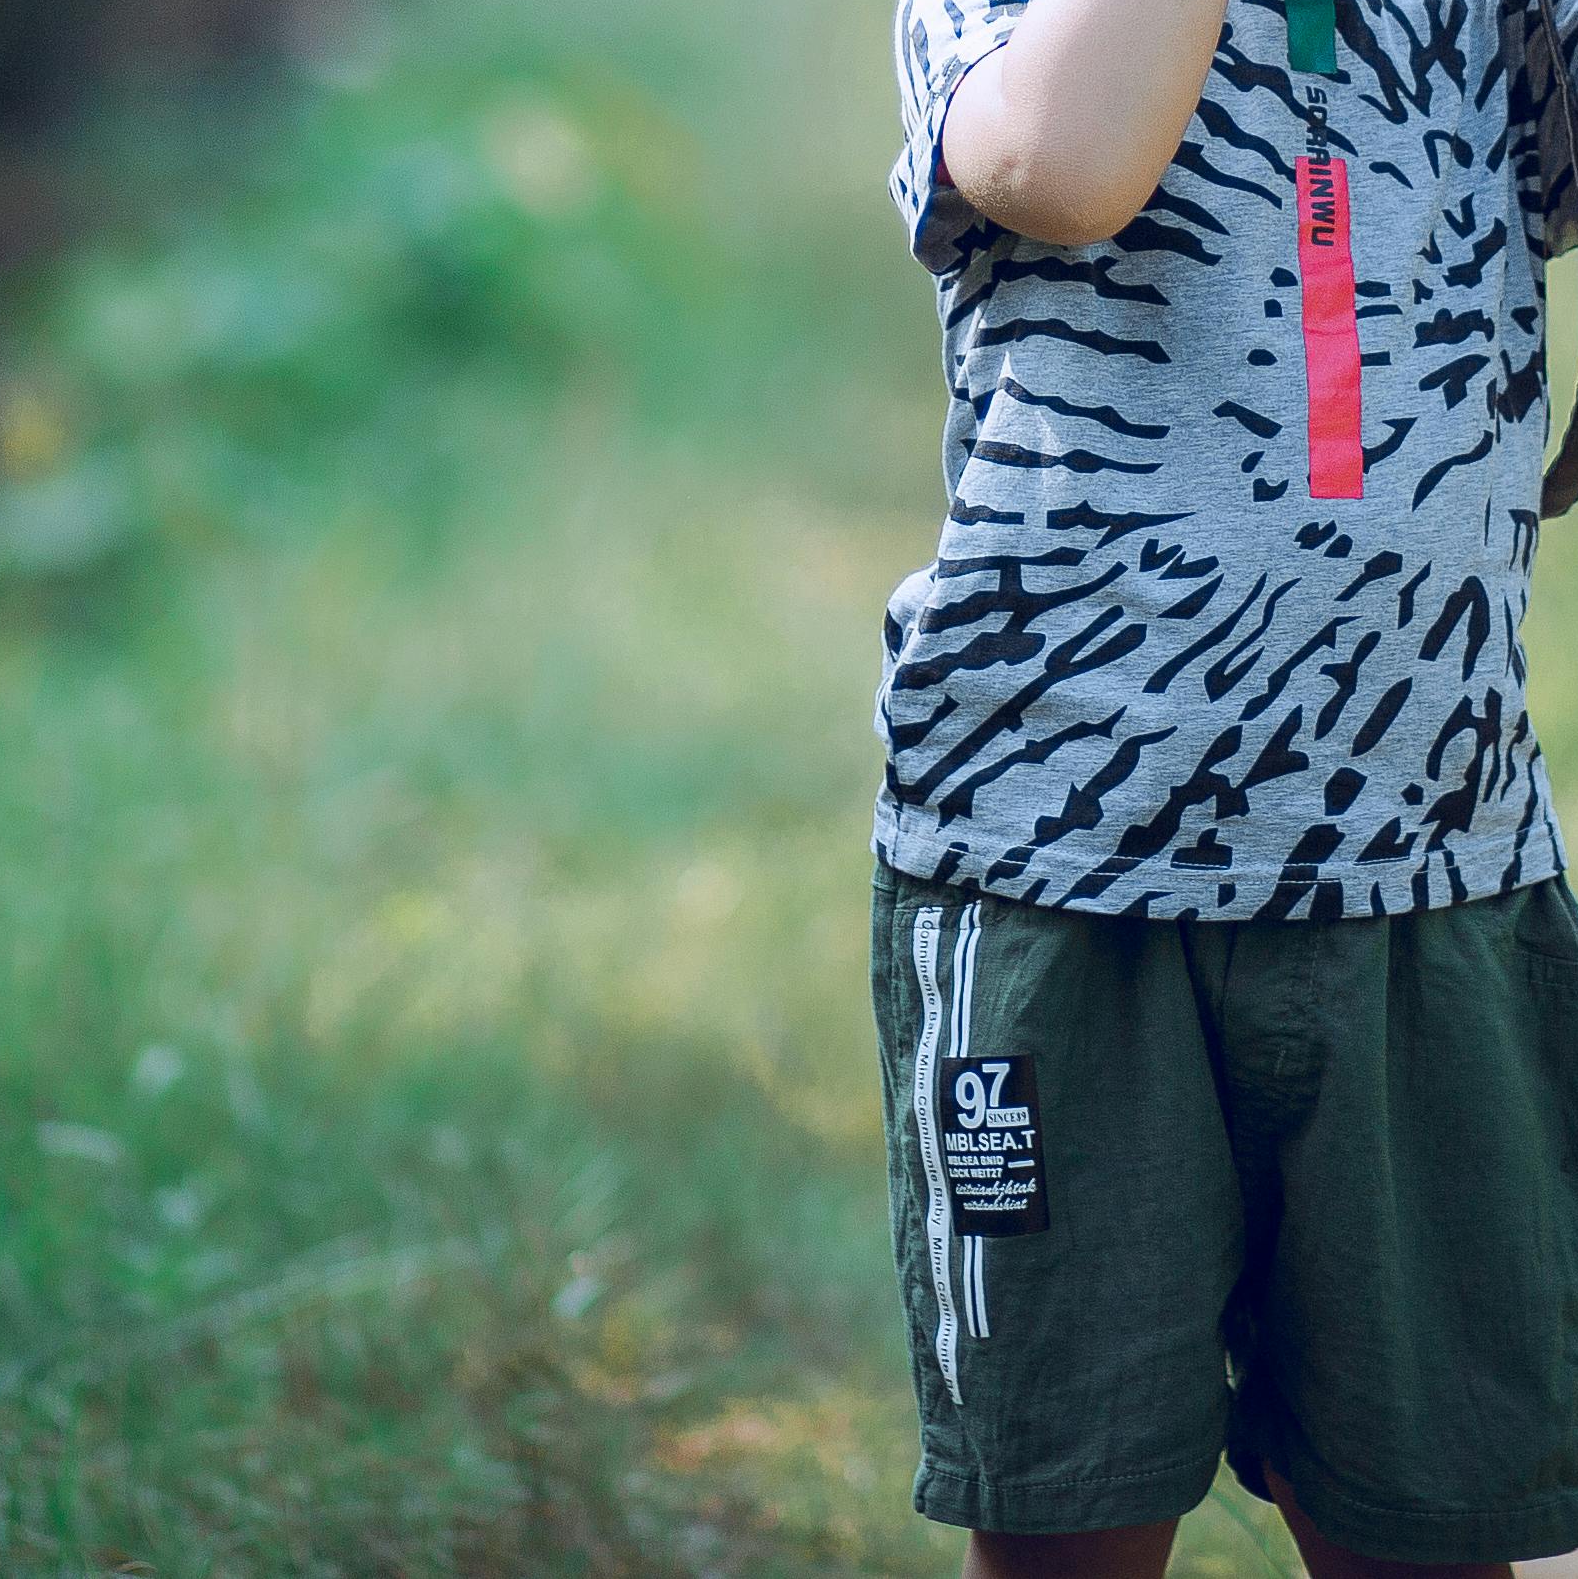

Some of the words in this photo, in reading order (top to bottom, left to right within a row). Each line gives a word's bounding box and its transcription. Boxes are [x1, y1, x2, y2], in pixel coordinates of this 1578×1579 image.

[921, 1011, 937, 1048] Baby
[918, 1054, 928, 1090] Mine
[955, 1063, 1010, 1129] 97
[945, 1130, 1036, 1152] MBLSEA.T
[931, 1187, 944, 1225] Baby
[933, 1237, 942, 1275] Mine
